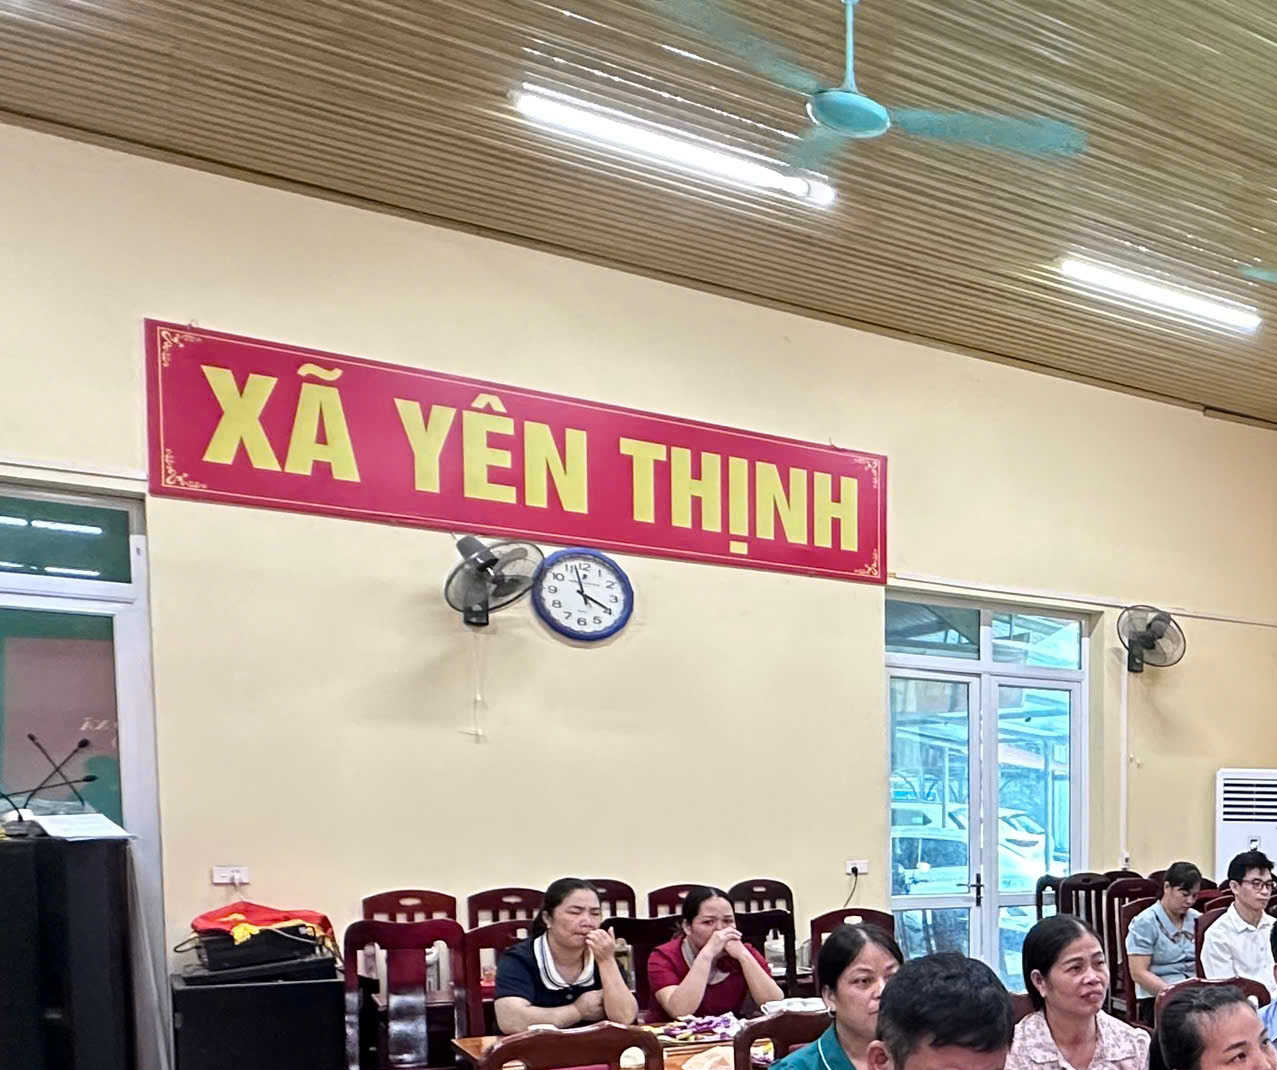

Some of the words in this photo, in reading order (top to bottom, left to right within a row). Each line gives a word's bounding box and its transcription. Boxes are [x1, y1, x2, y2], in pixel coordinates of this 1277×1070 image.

[201, 362, 361, 483] XÃ
[394, 393, 589, 515] YÊN
[619, 437, 859, 555] THỊNH
[578, 563, 591, 571] 12
[552, 572, 565, 582] 10
[605, 580, 616, 589] 2
[548, 585, 558, 594] 9
[609, 595, 619, 604] 3
[552, 600, 562, 609] 8
[563, 611, 573, 620] 7
[577, 618, 588, 627] 6
[593, 616, 602, 625] 5
